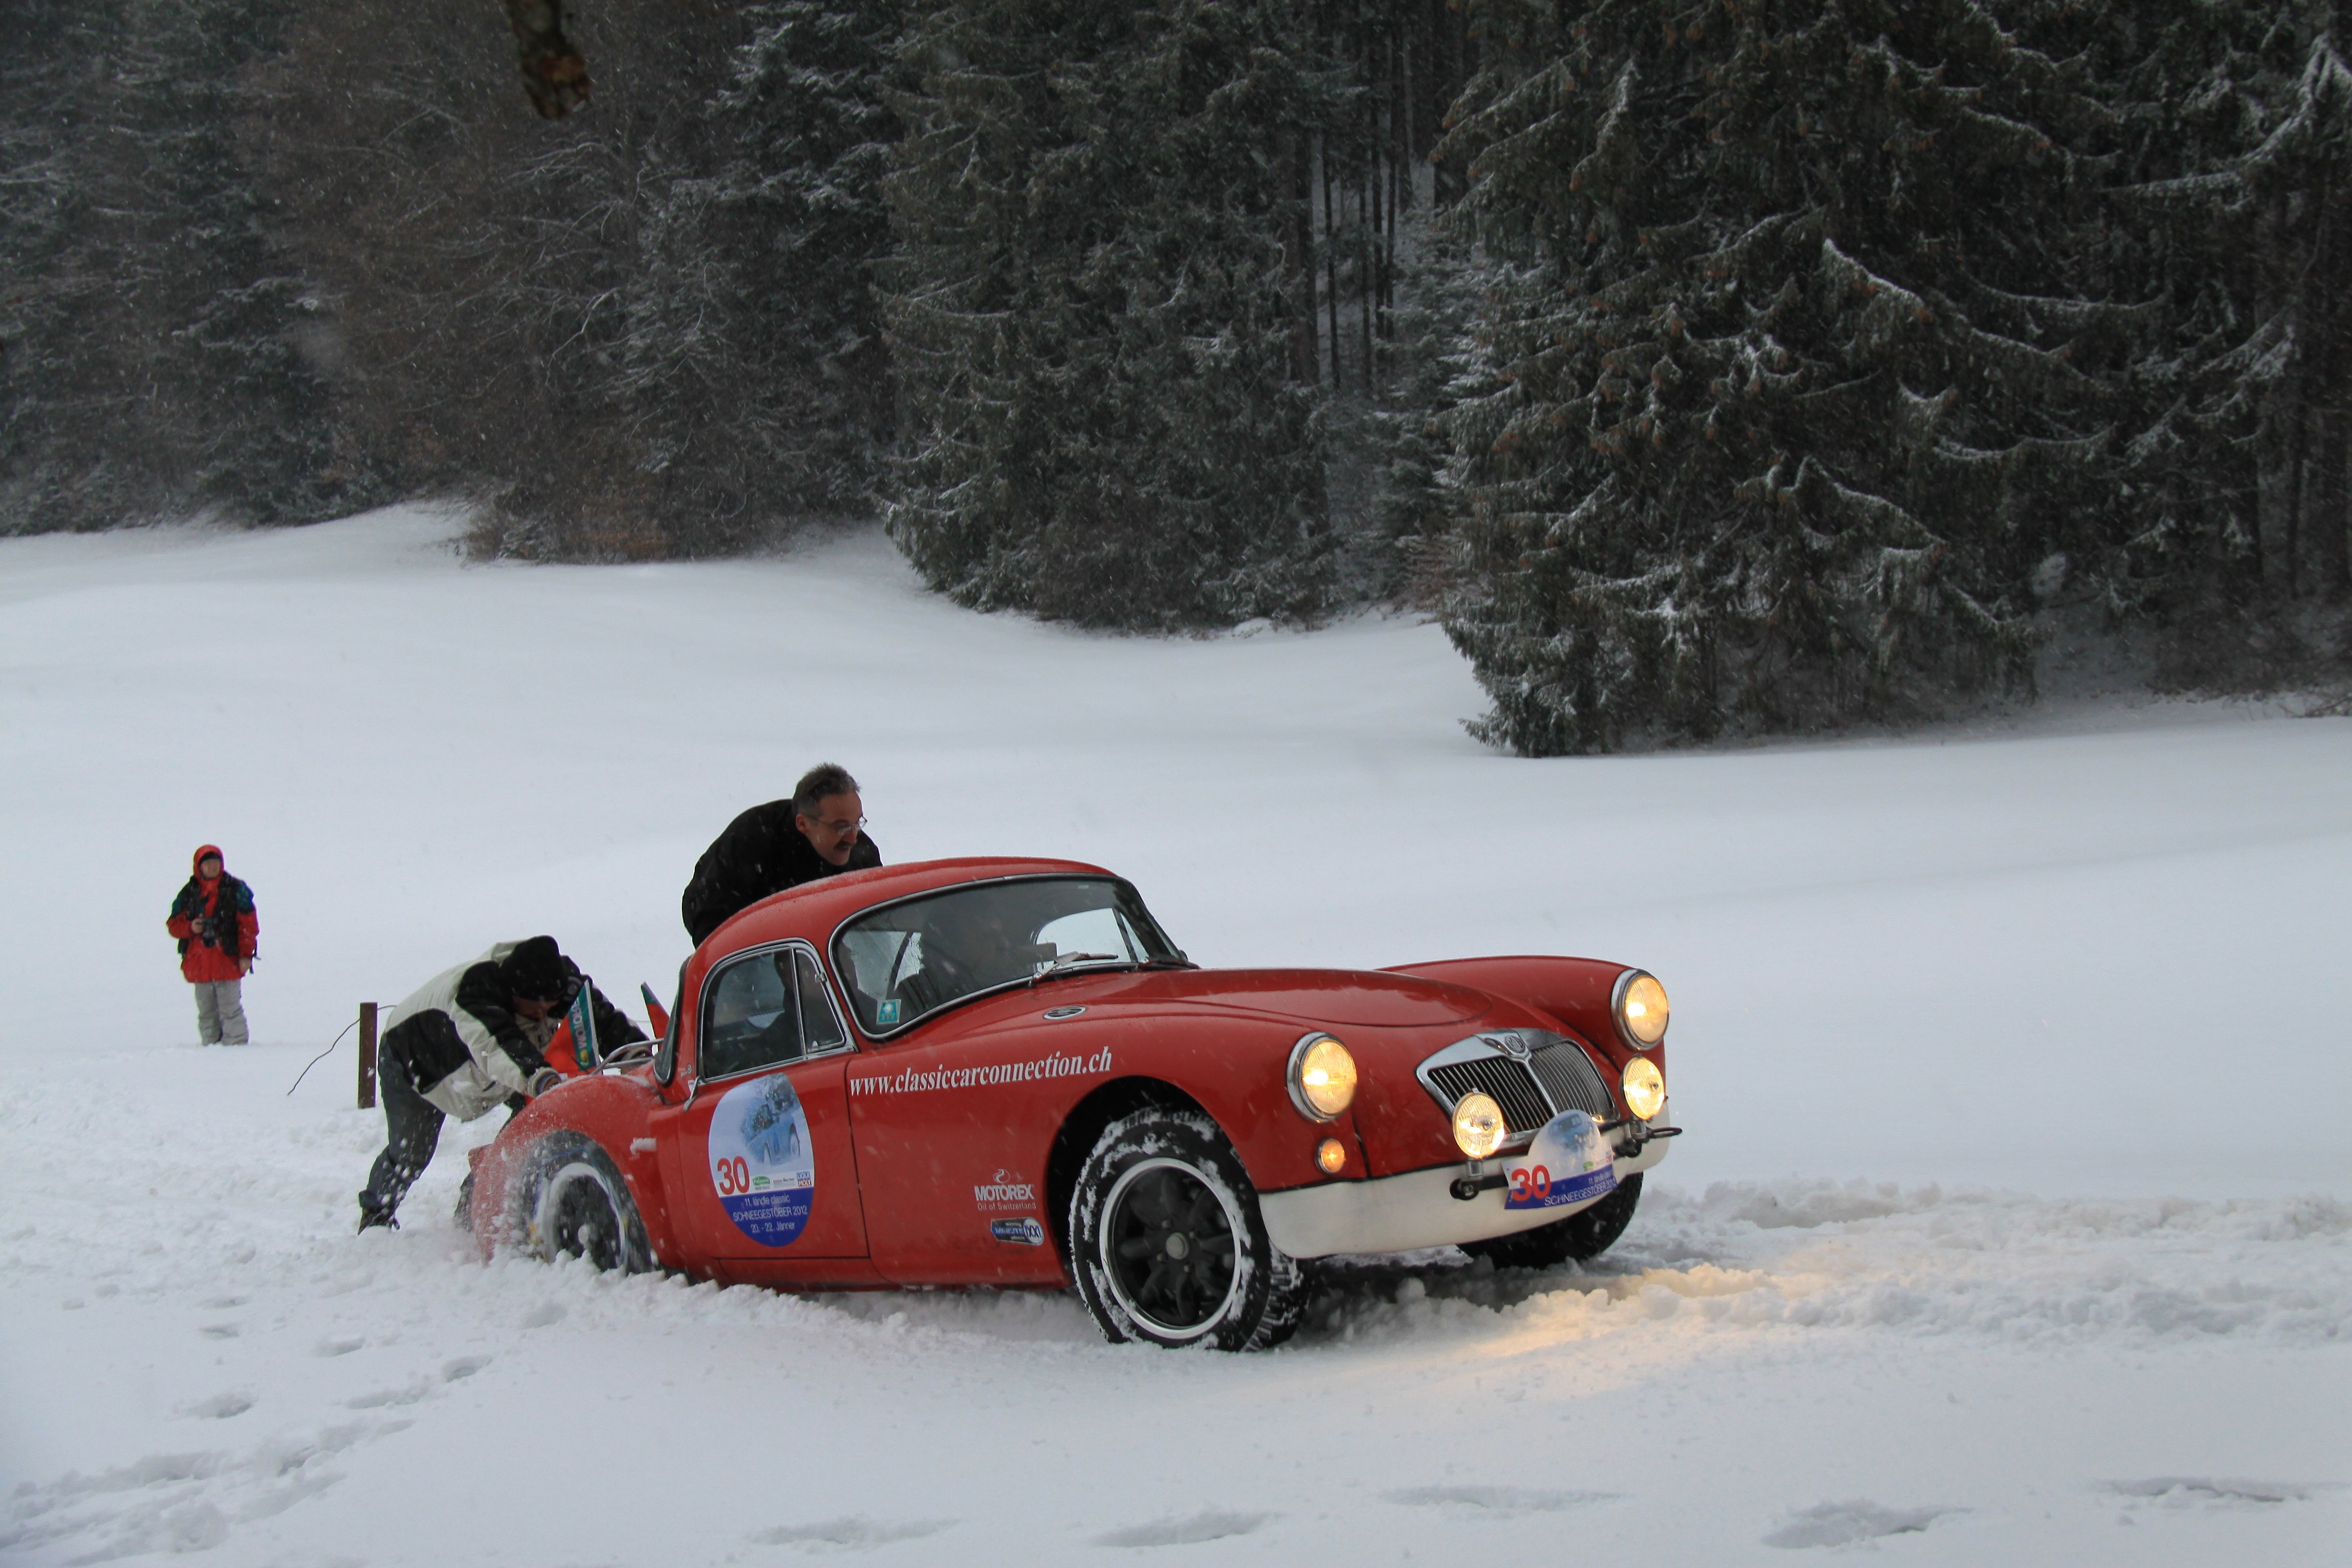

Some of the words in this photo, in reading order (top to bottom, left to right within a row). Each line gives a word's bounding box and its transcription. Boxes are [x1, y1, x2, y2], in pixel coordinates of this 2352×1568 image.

[849, 1046, 1112, 1096] www.classiccarconnection.ch
[717, 1156, 750, 1195] 30
[1511, 1165, 1551, 1202] 30
[771, 1193, 790, 1205] classic
[974, 1184, 1035, 1201] MOTOREX
[793, 1205, 807, 1215] 2012
[997, 1201, 1036, 1210] Switzerland
